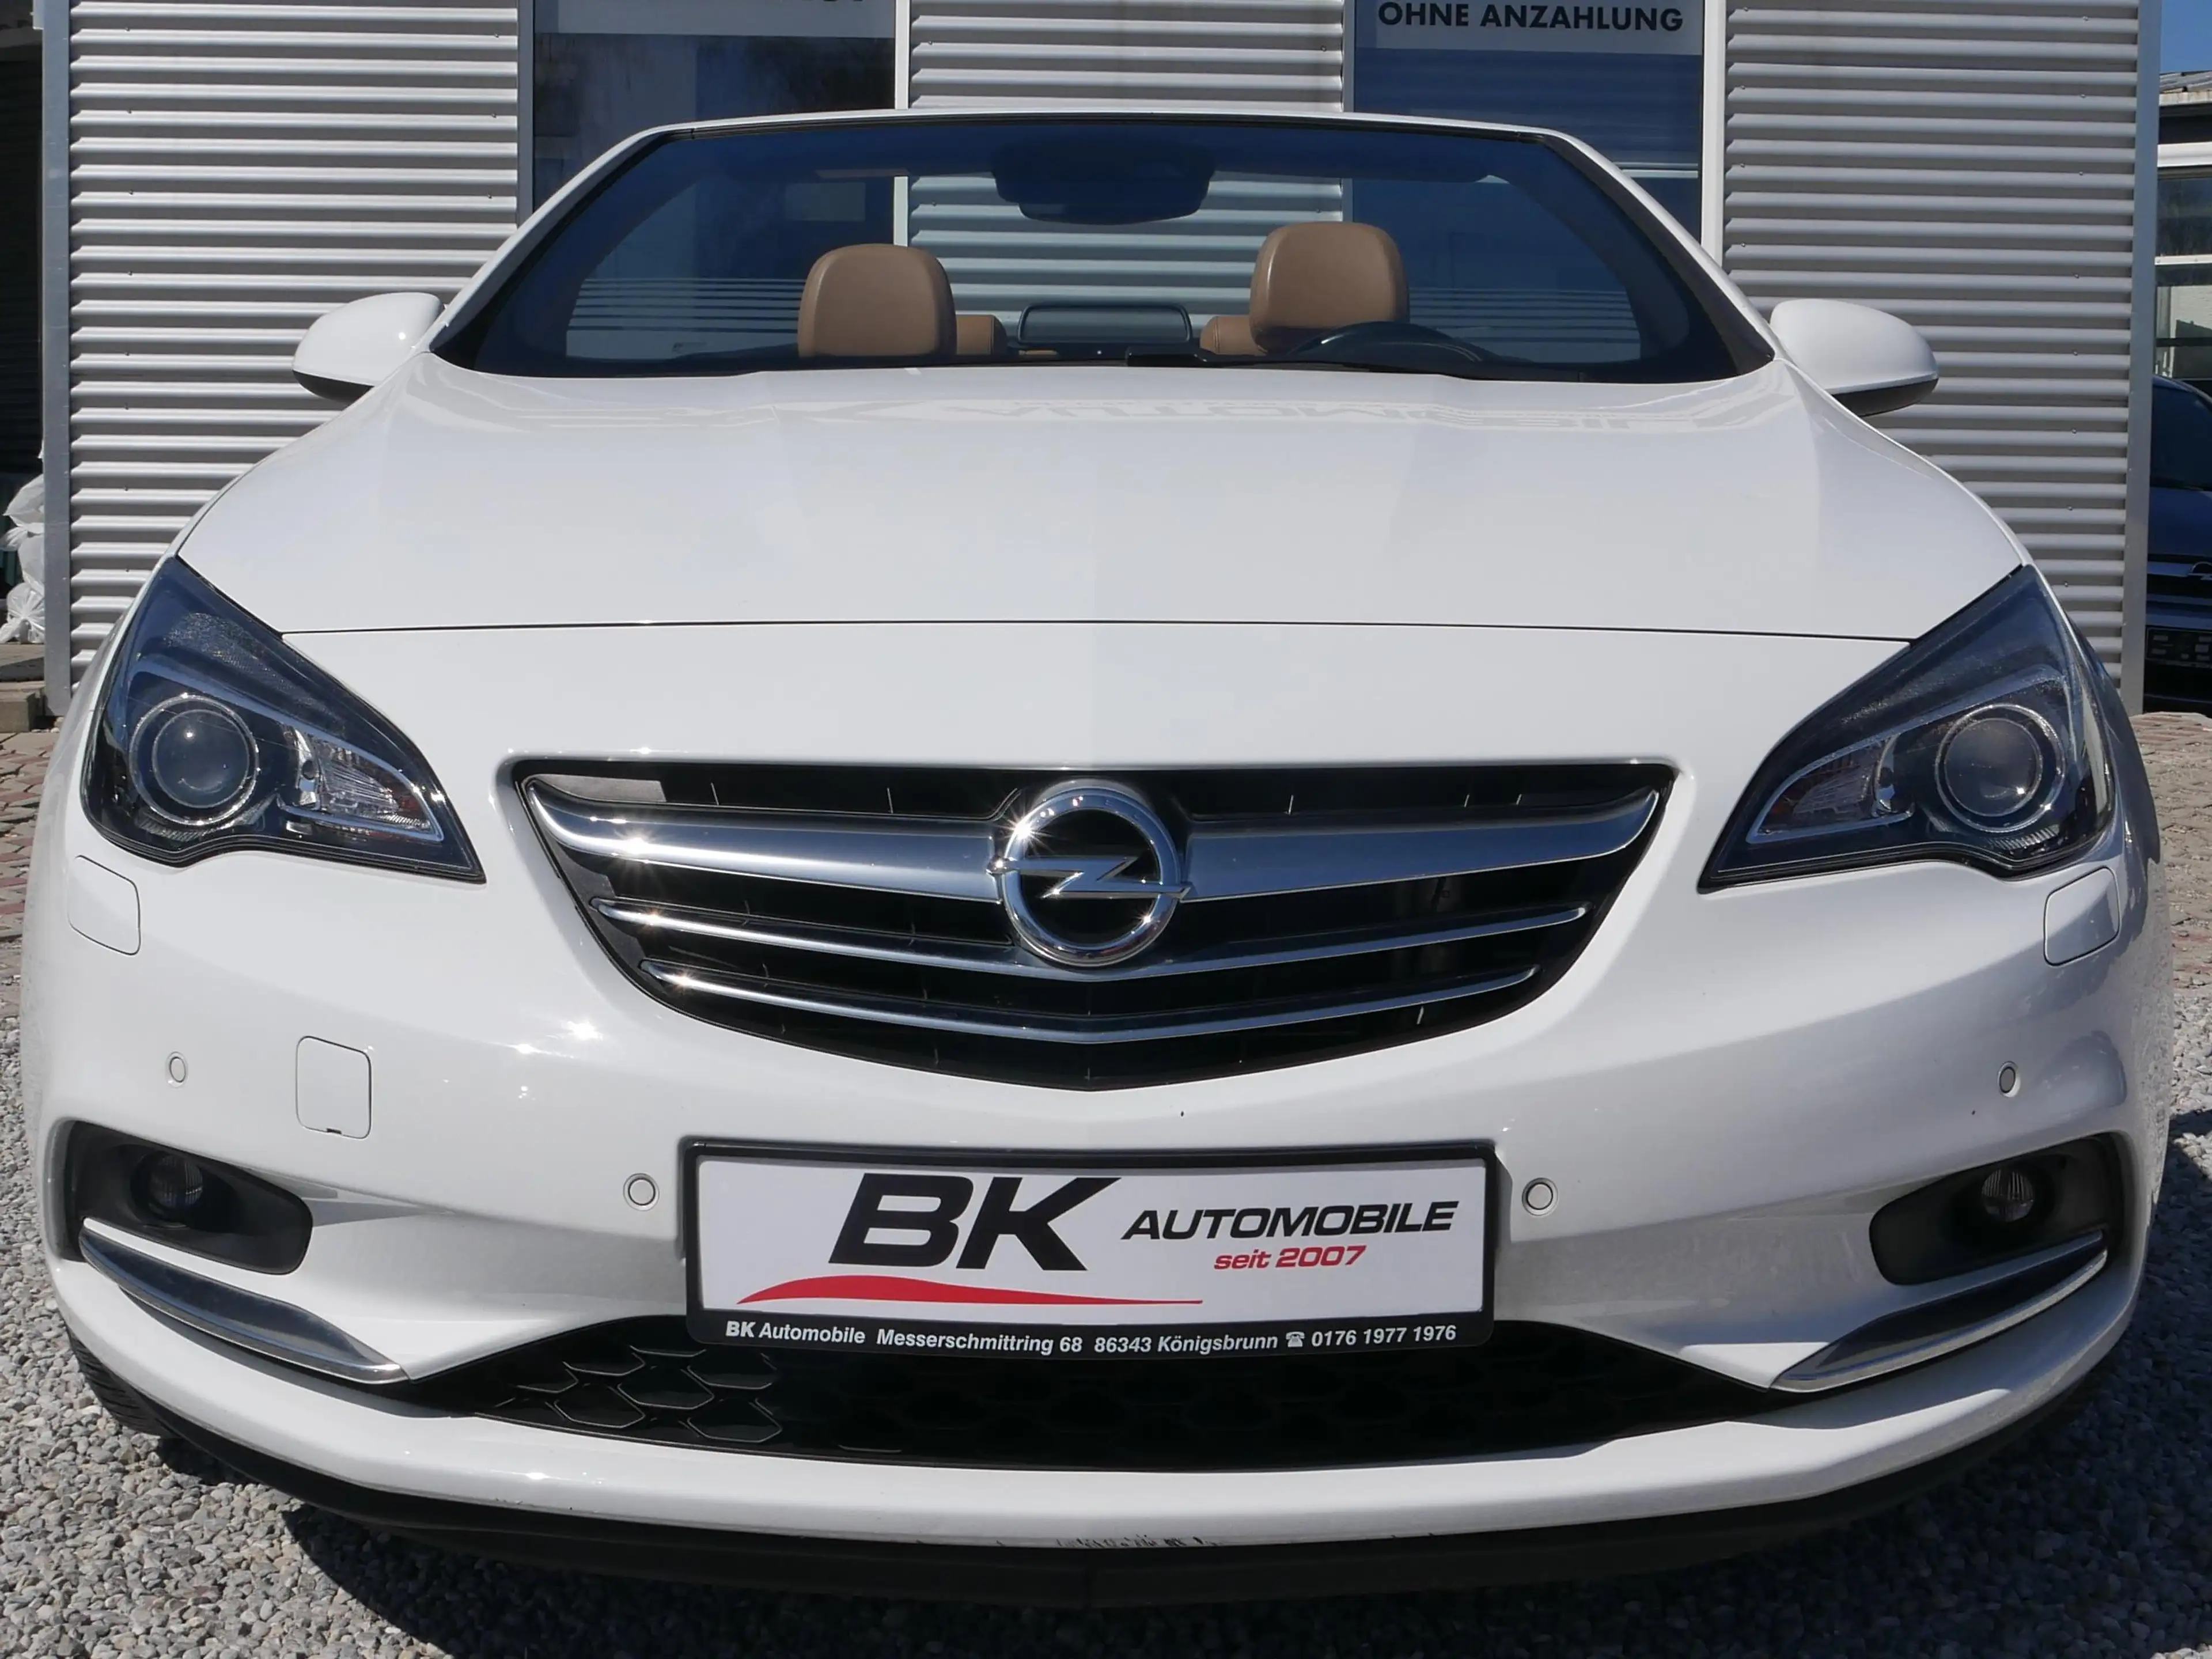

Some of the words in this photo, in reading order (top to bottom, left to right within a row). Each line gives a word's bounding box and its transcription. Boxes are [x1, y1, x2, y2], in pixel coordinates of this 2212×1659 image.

[1378, 2, 1469, 26] OHNE
[1480, 4, 1683, 31] ANZAHLUNG
[828, 1172, 1121, 1271] BK
[1121, 1201, 1459, 1240] AUTOMOBILE
[1214, 1249, 1271, 1270] seit
[1276, 1245, 1366, 1268] 2007
[725, 1320, 756, 1338] BK
[758, 1322, 866, 1344] Automobile
[876, 1328, 1054, 1355] Messerschmittring
[1059, 1336, 1083, 1353] 68
[1094, 1336, 1152, 1353] 86343
[1157, 1335, 1278, 1355] Königsbrunn
[1312, 1330, 1357, 1347] 0176
[1363, 1327, 1407, 1344] 1977
[1413, 1325, 1456, 1342] 1976
